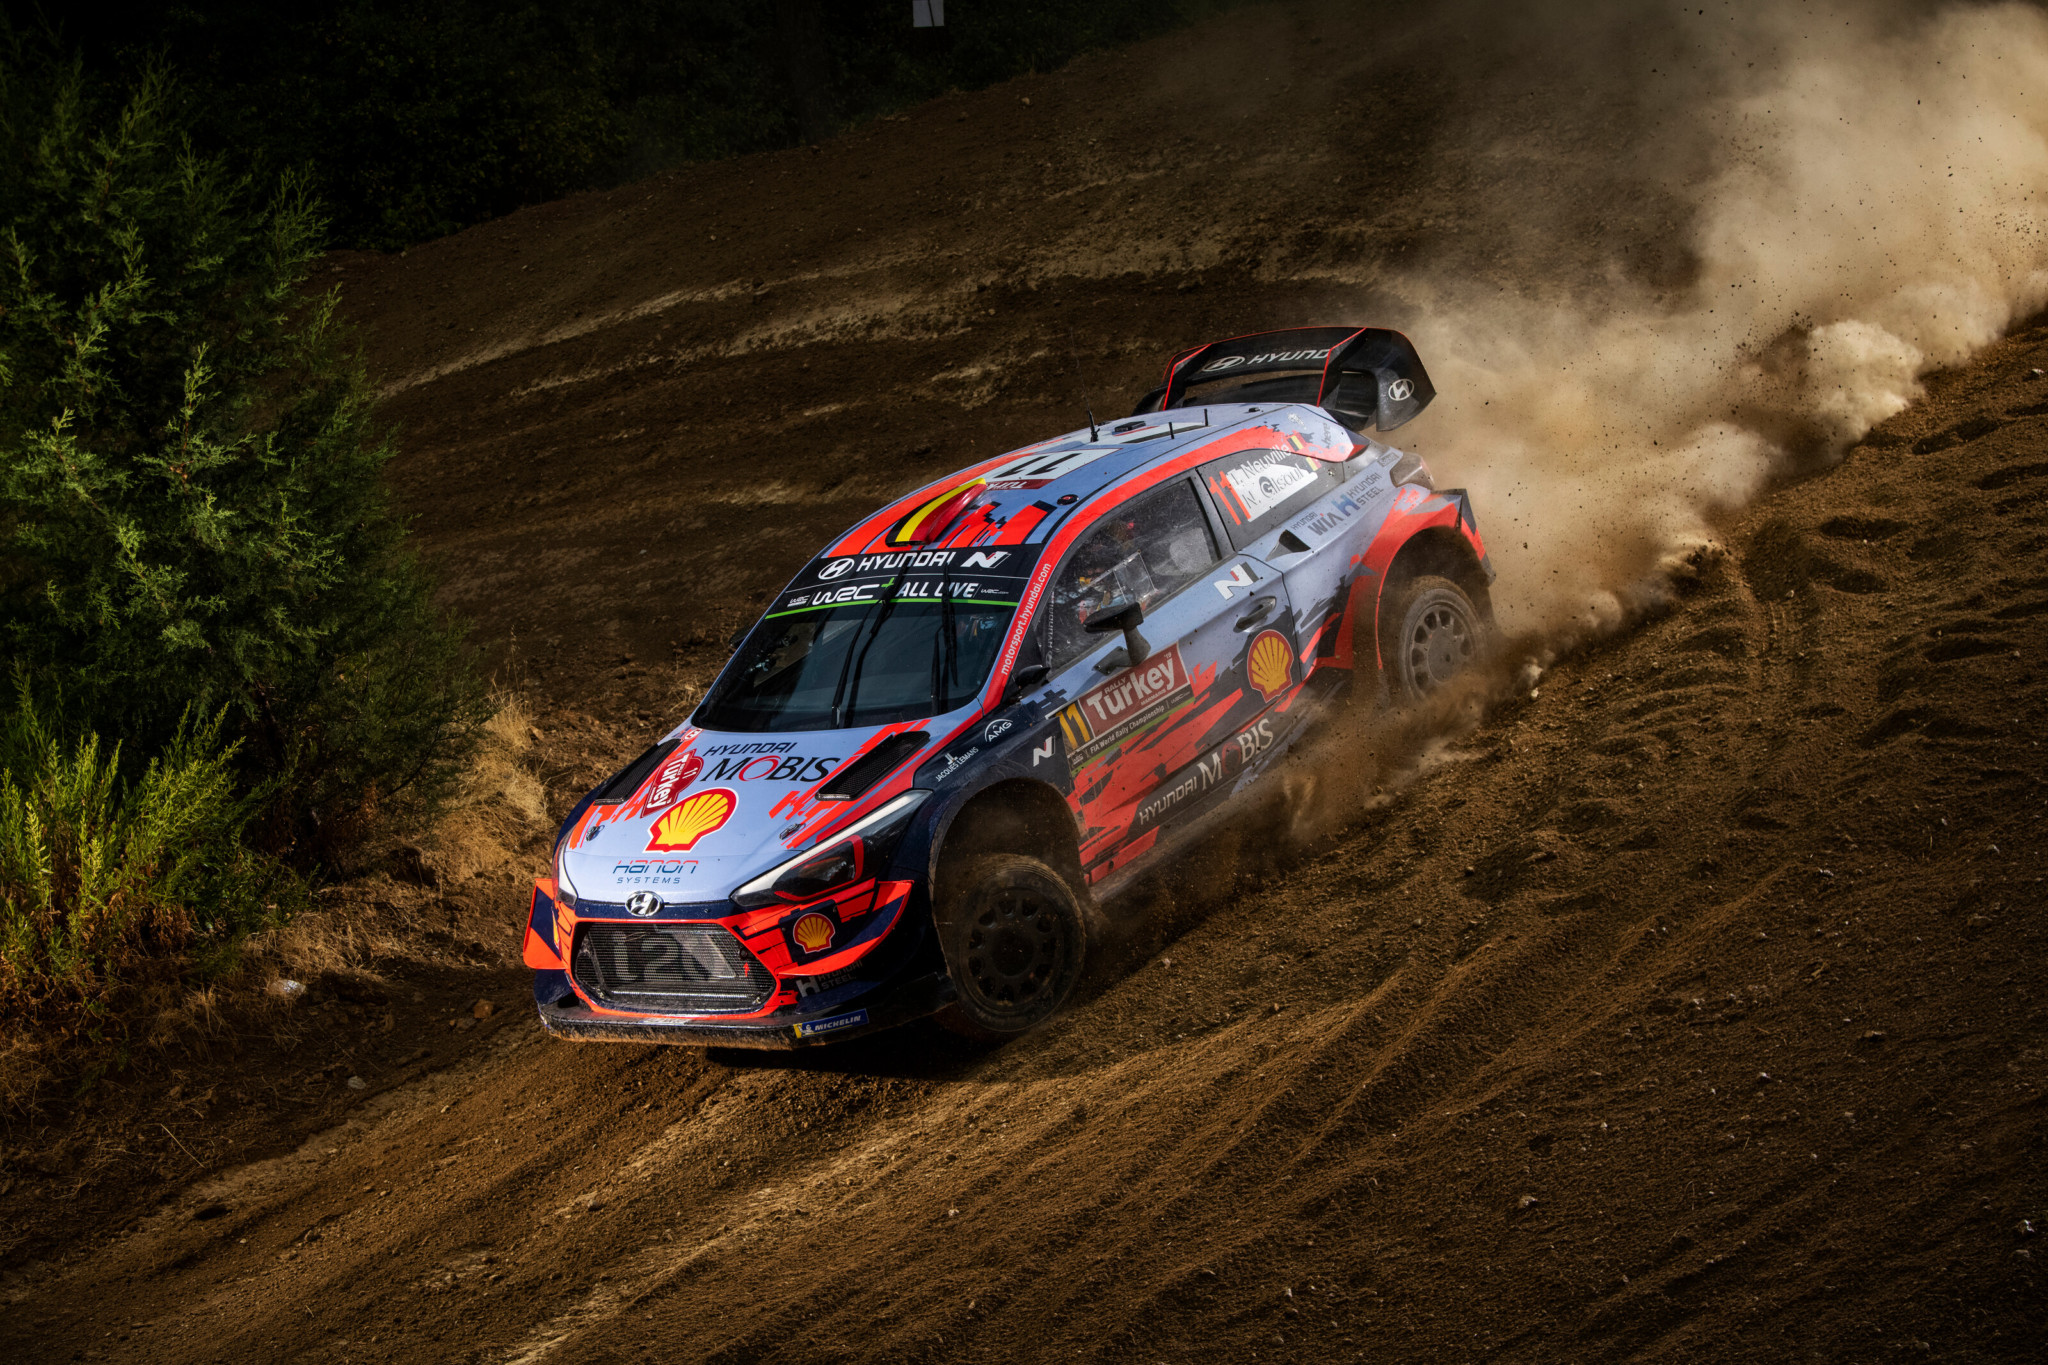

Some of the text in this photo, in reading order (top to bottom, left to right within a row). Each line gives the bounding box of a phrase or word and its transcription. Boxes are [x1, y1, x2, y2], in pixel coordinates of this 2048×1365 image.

[1240, 443, 1291, 478] Neuville
[987, 481, 1028, 490] Turk
[1209, 471, 1251, 526] 11
[1347, 472, 1382, 499] HYUNDAI
[1356, 487, 1384, 506] STEEL
[1241, 490, 1262, 509] N.
[1291, 511, 1318, 530] HYUNDAI
[856, 552, 956, 573] HYUNDAI
[898, 582, 929, 598] ALL
[1001, 563, 1052, 675] motorsport.hyundai.com
[1086, 658, 1175, 720] Turkey
[1104, 677, 1126, 695] RALLY
[1056, 703, 1091, 750] 11
[1090, 744, 1100, 754] FIA
[1100, 735, 1115, 748] World
[1115, 725, 1129, 740] Rally
[1129, 706, 1165, 730] Championship
[703, 742, 797, 756] HYUNDAI
[700, 755, 840, 782] MOBIS
[936, 747, 979, 782] JACQUES LEMANS
[1139, 718, 1274, 825] HYUNDAI MOBIS
[647, 754, 690, 808] Turkey
[821, 974, 855, 990] STEEL
[815, 1015, 862, 1031] MICHELIN
